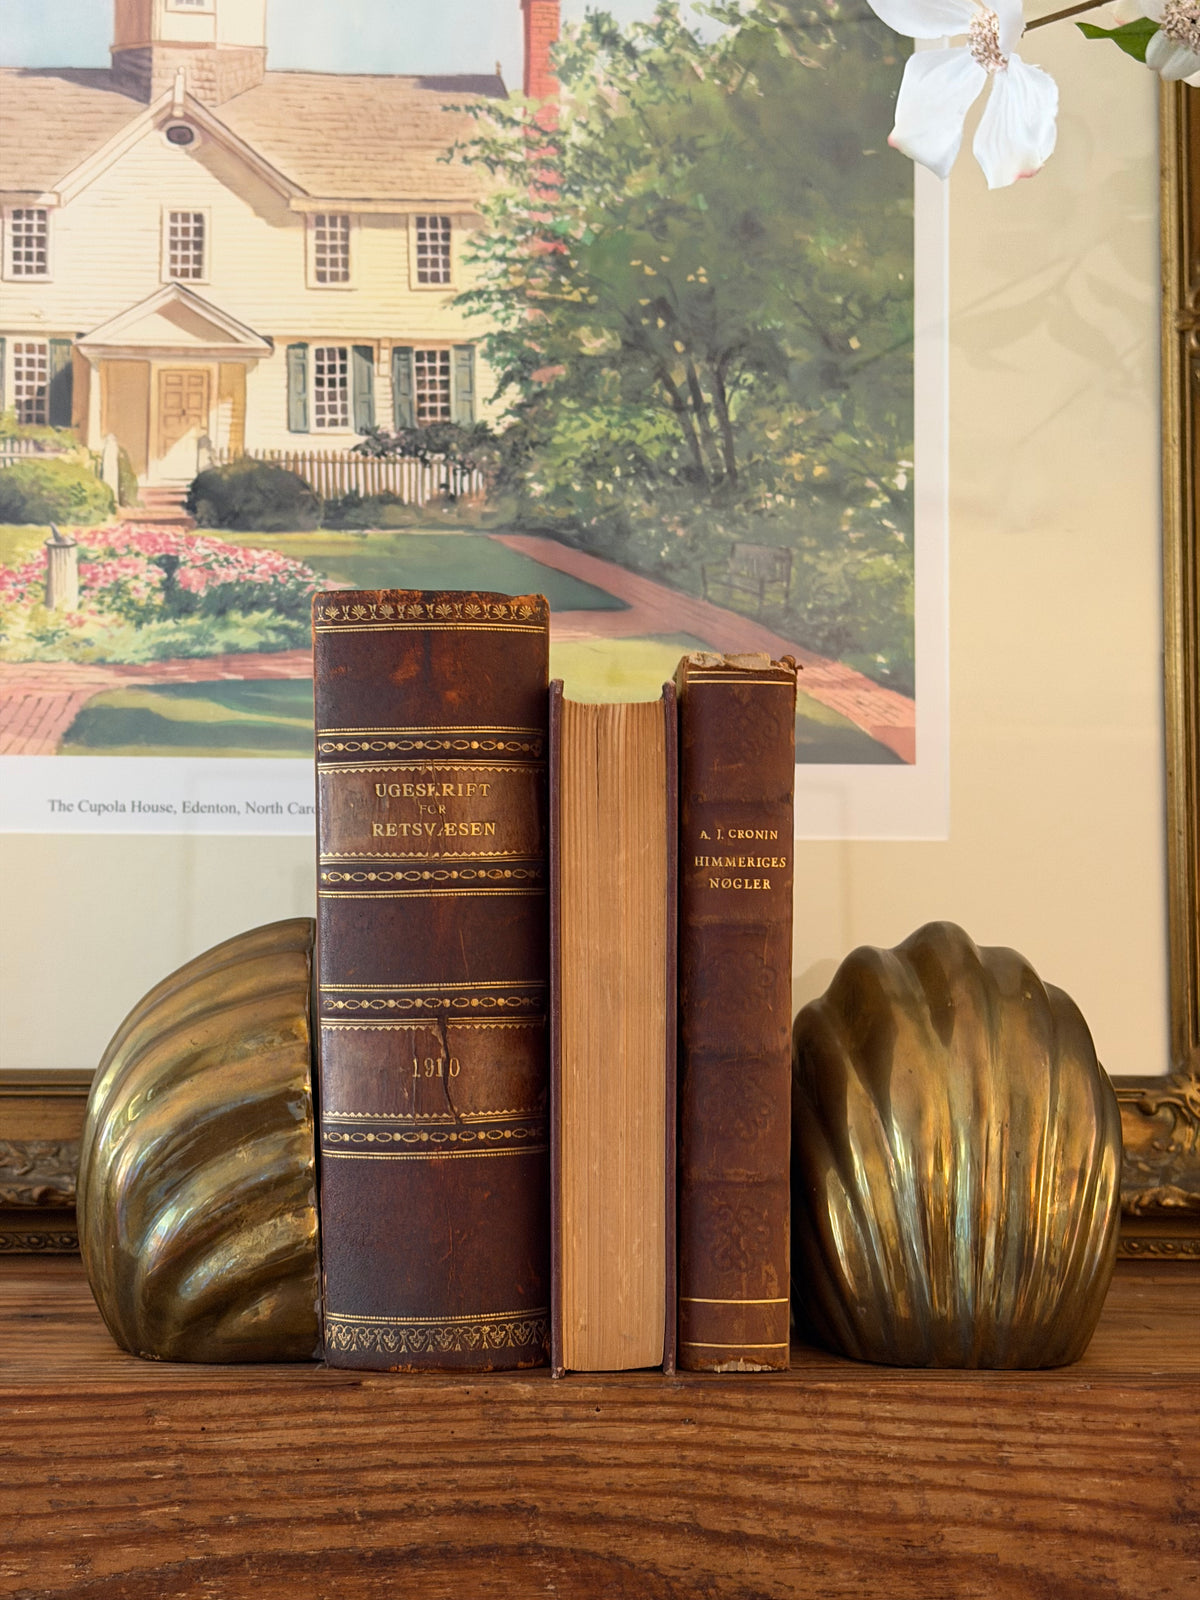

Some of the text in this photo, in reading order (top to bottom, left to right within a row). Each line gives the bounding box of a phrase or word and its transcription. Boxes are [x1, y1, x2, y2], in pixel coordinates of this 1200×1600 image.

[375, 783, 491, 797] UGESKRIFT
[48, 799, 75, 813] The
[77, 799, 126, 816] Cupola
[131, 800, 178, 815] House,
[182, 800, 241, 816] Edenton,
[245, 801, 284, 815] North
[419, 804, 447, 815] FOR
[372, 822, 496, 837] RETSVÆSEN
[700, 828, 779, 840] A. J. CRONIN
[694, 856, 787, 868] HIMMERIGES
[709, 878, 772, 890] NØGLER
[412, 1057, 461, 1078] 1910
